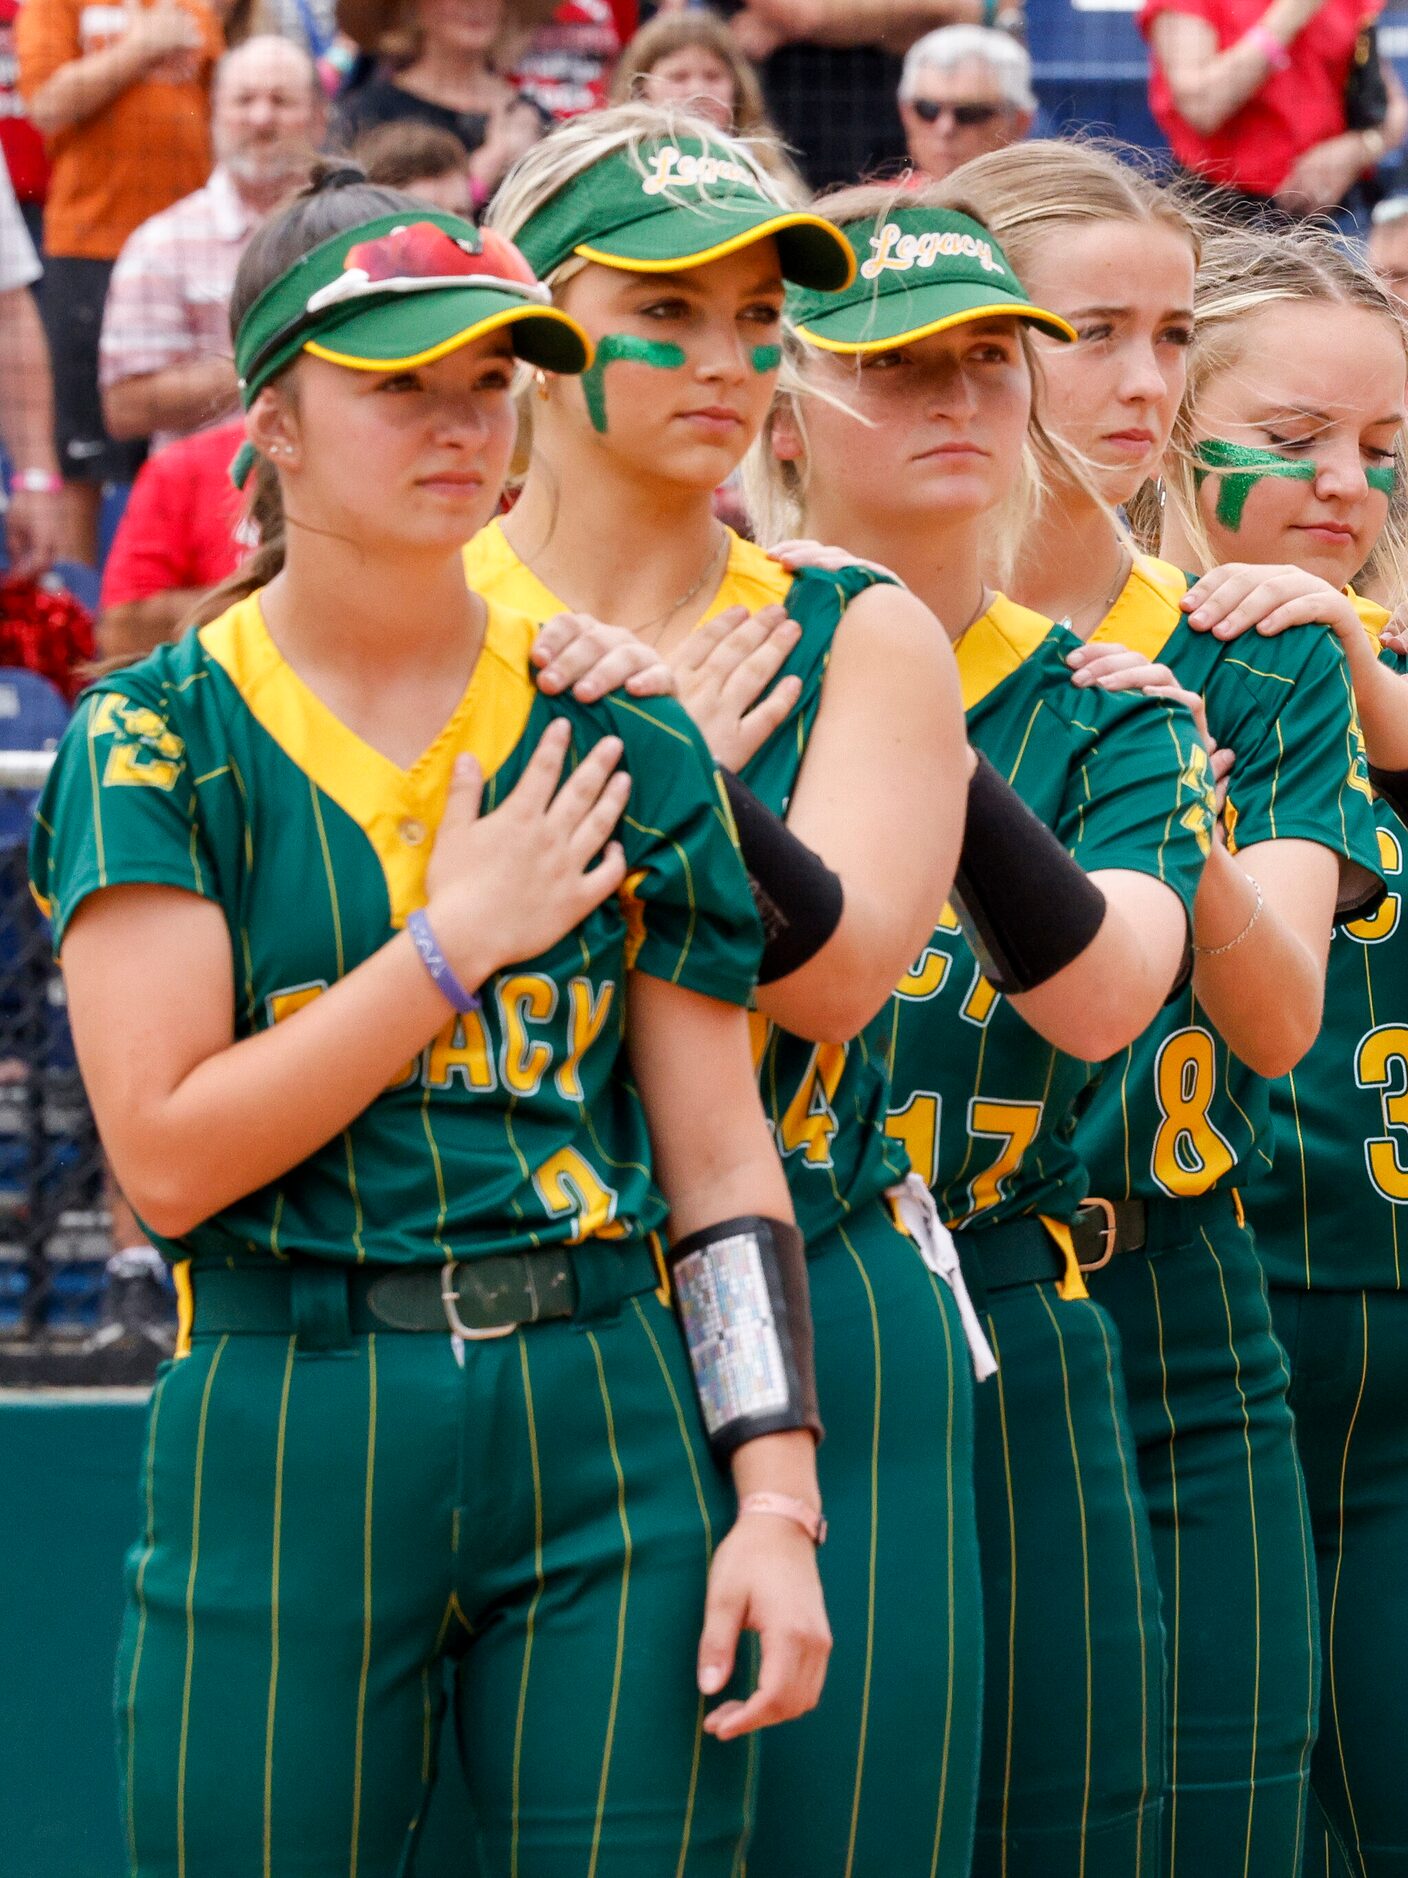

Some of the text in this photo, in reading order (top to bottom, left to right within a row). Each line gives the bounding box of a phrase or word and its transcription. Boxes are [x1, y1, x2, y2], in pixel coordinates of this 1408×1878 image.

[642, 146, 758, 195] Lega
[860, 223, 1005, 279] Legacy
[884, 1089, 1045, 1231] 17
[1149, 1025, 1239, 1199] 8
